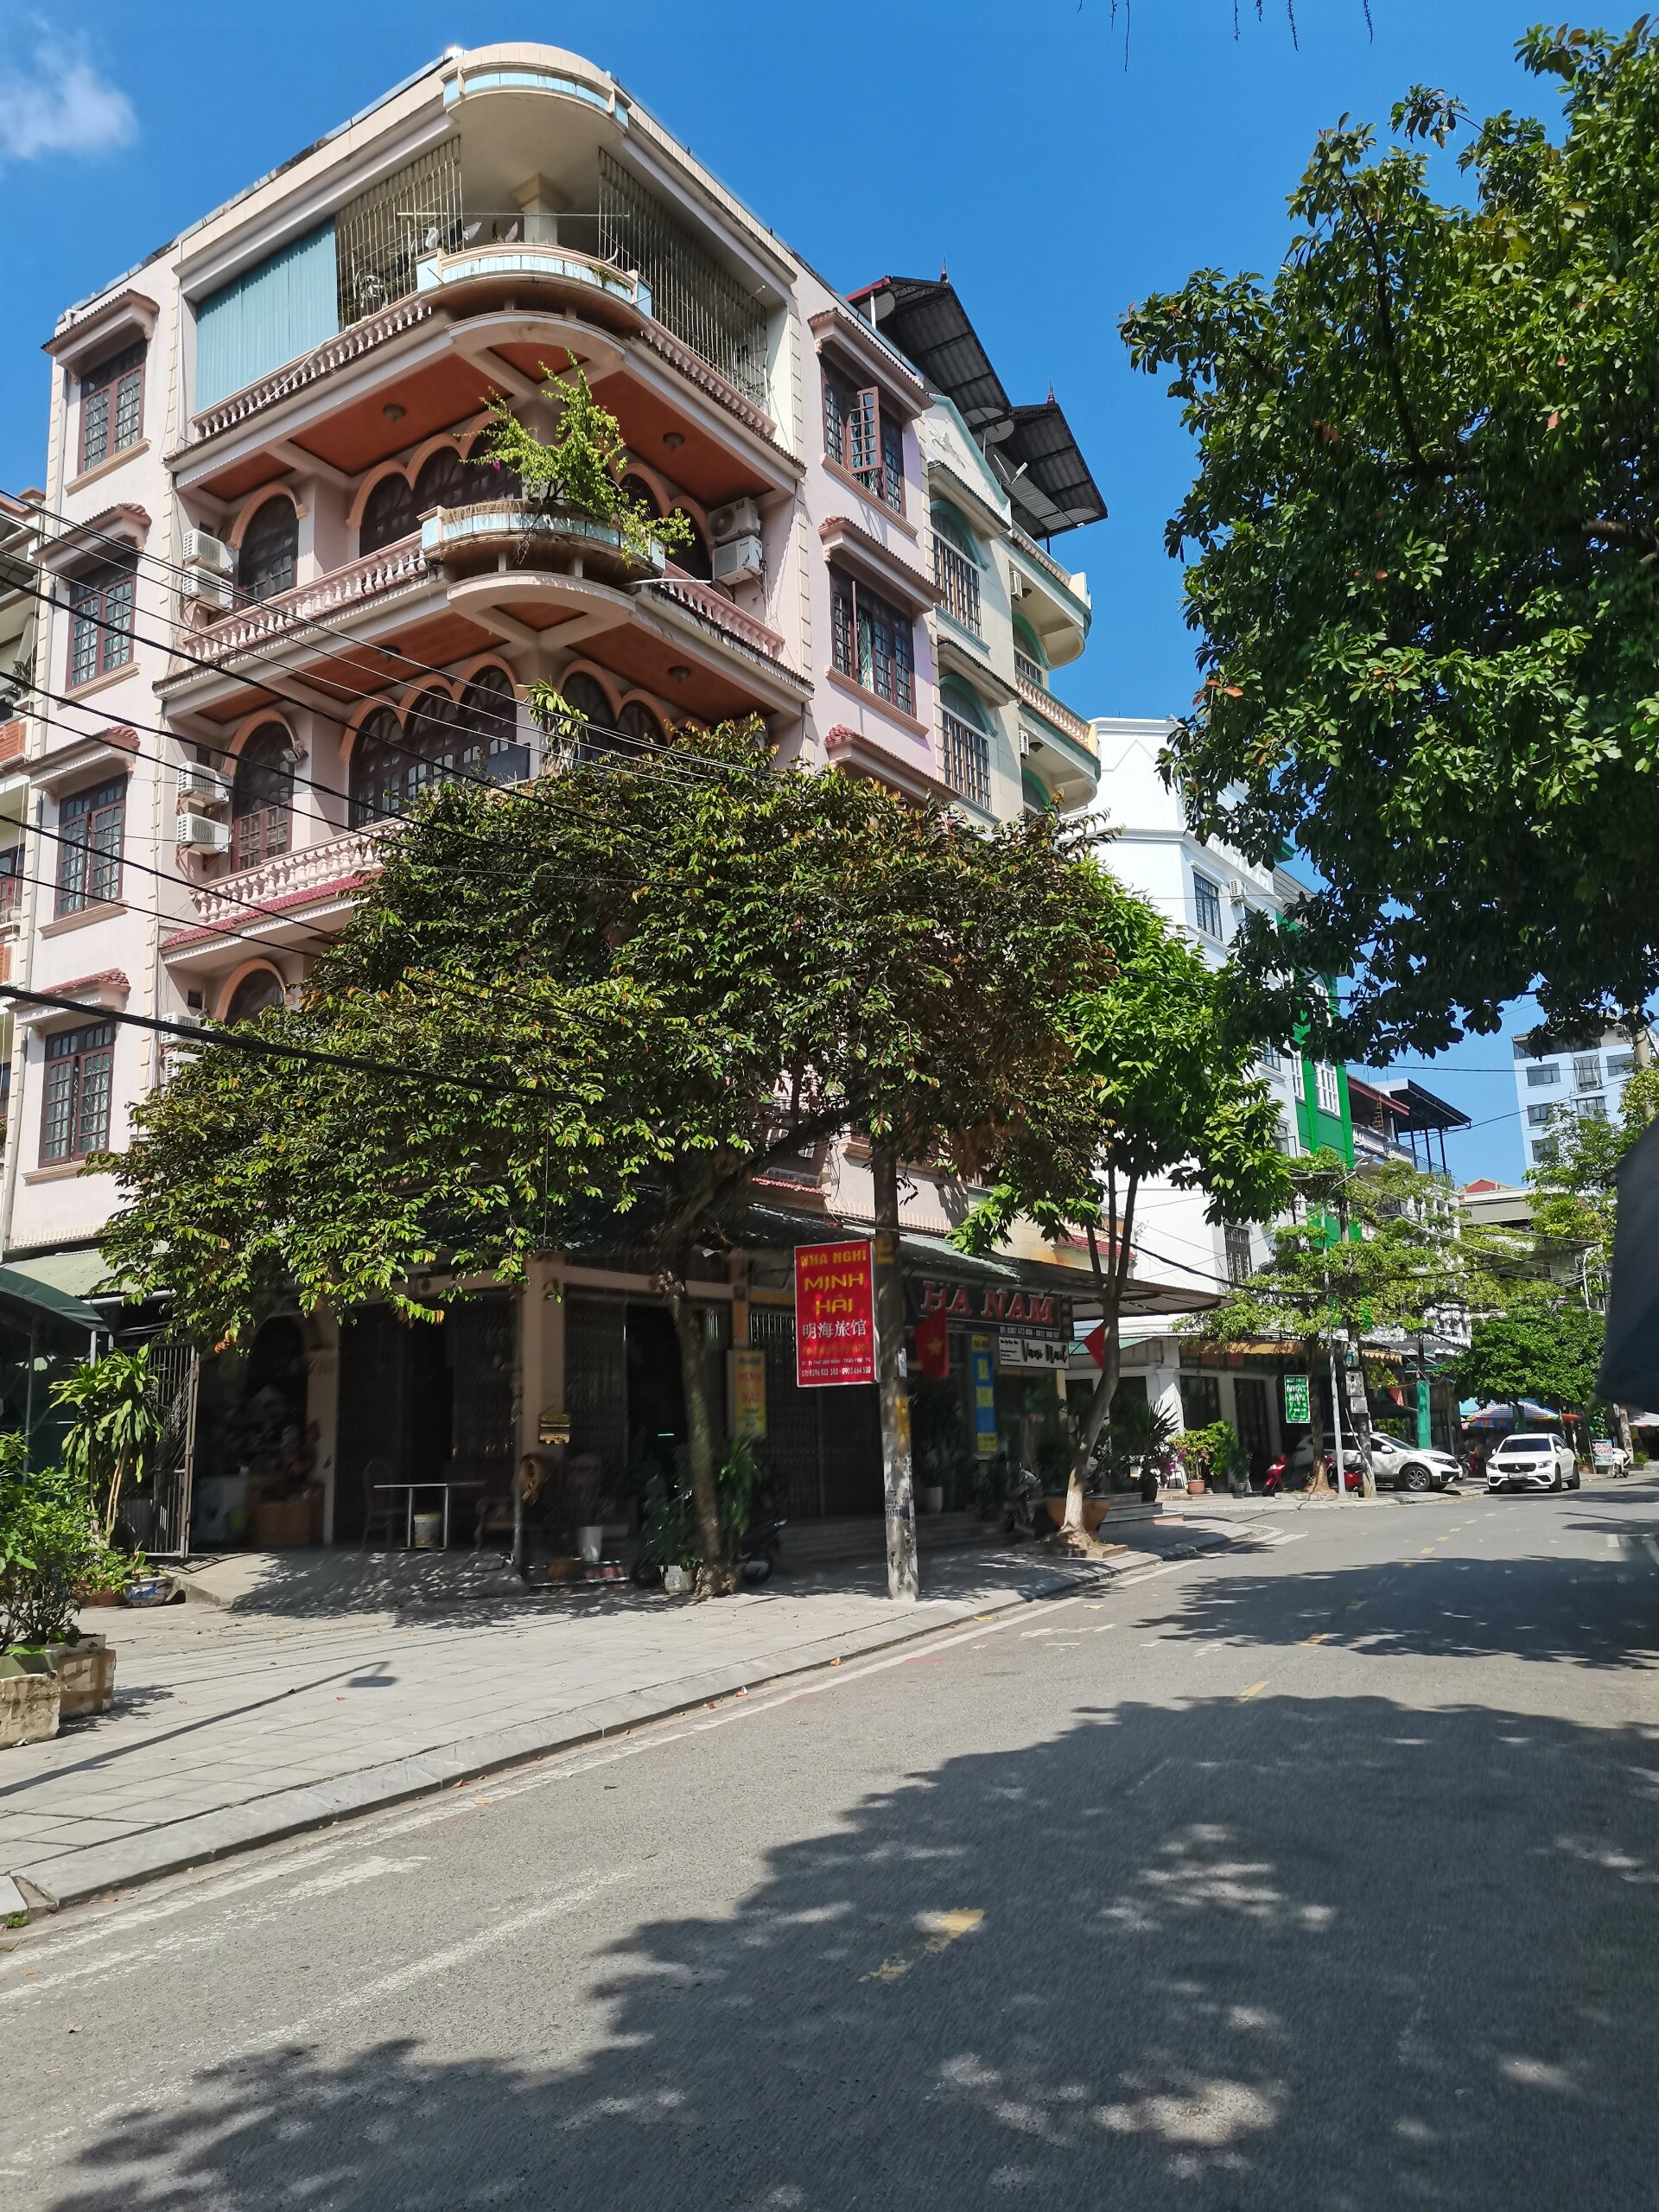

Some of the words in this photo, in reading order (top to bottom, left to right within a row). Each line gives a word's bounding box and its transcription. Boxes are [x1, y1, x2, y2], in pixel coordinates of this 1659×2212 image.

[804, 1273, 863, 1292] MINH
[981, 1287, 1055, 1325] NAM
[802, 1319, 867, 1340] 明海旅馆
